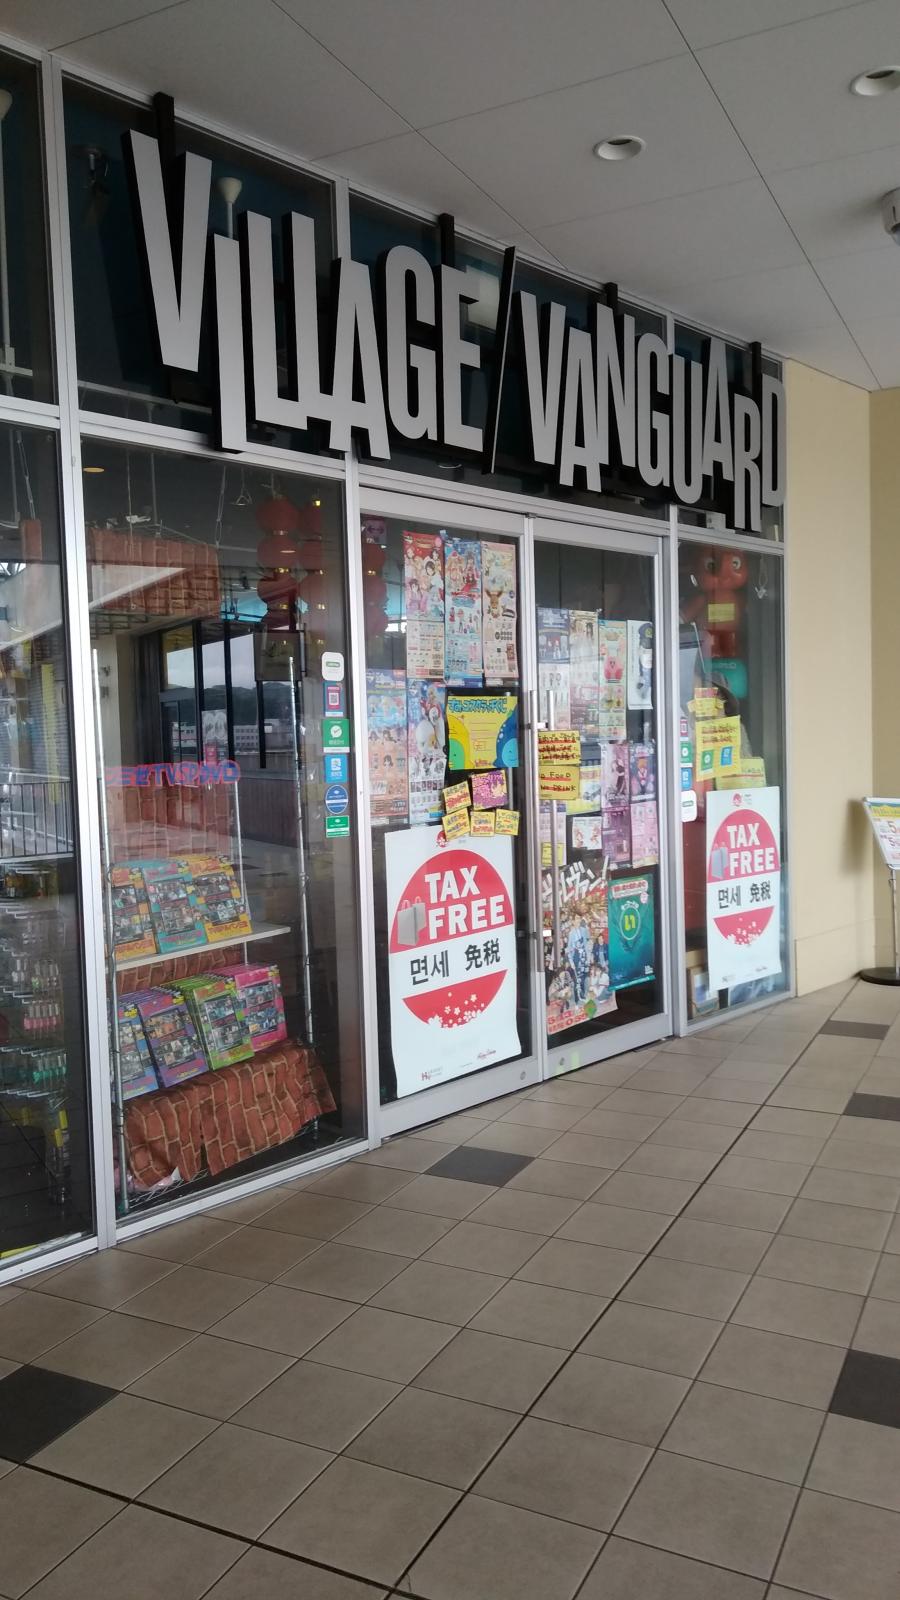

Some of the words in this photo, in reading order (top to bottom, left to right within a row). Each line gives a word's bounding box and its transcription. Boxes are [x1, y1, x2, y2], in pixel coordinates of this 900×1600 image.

[124, 130, 484, 460] VILLAGE
[520, 290, 787, 533] VANGUARD
[727, 822, 760, 849] TAX
[729, 847, 775, 877] FREE
[424, 865, 480, 904] TAX
[717, 884, 742, 910] 면세
[749, 880, 772, 903] 免税
[428, 894, 506, 940] FREE
[410, 949, 450, 986] 면세
[464, 937, 501, 971] 免税
